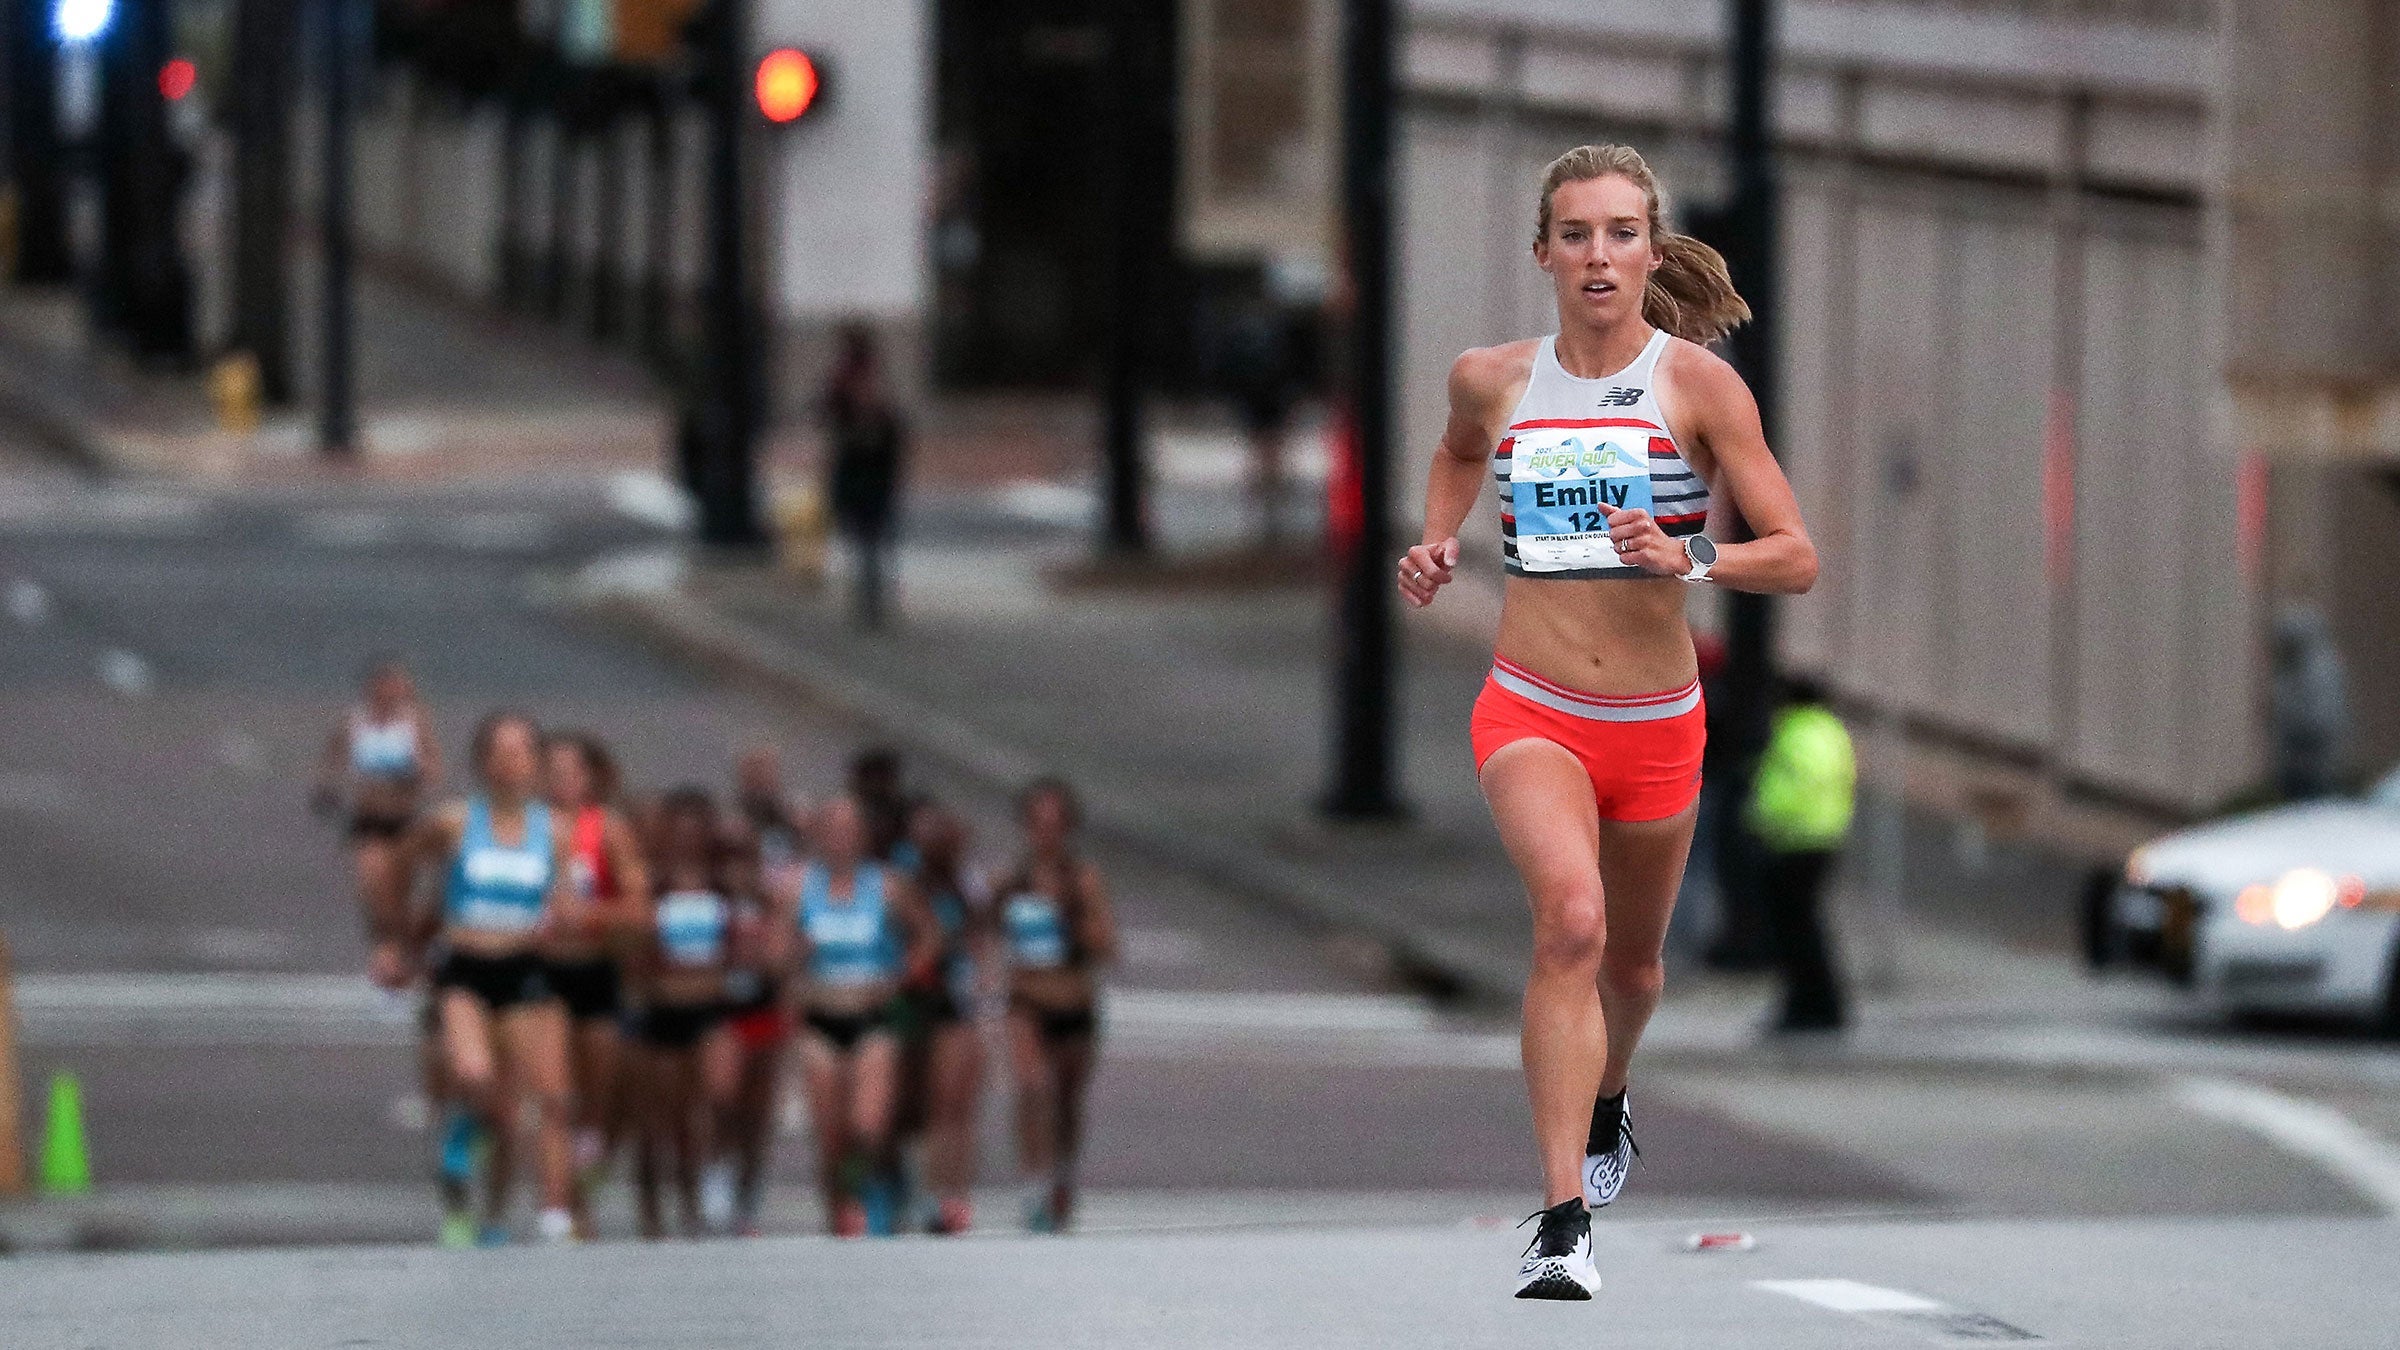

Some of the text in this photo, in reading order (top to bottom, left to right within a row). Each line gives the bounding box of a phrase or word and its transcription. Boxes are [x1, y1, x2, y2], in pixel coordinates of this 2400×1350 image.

[1597, 386, 1645, 406] NB
[1529, 453, 1577, 469] RIVER
[1535, 447, 1552, 455] 2021
[1535, 479, 1629, 508] Emily
[1568, 511, 1602, 532] 12
